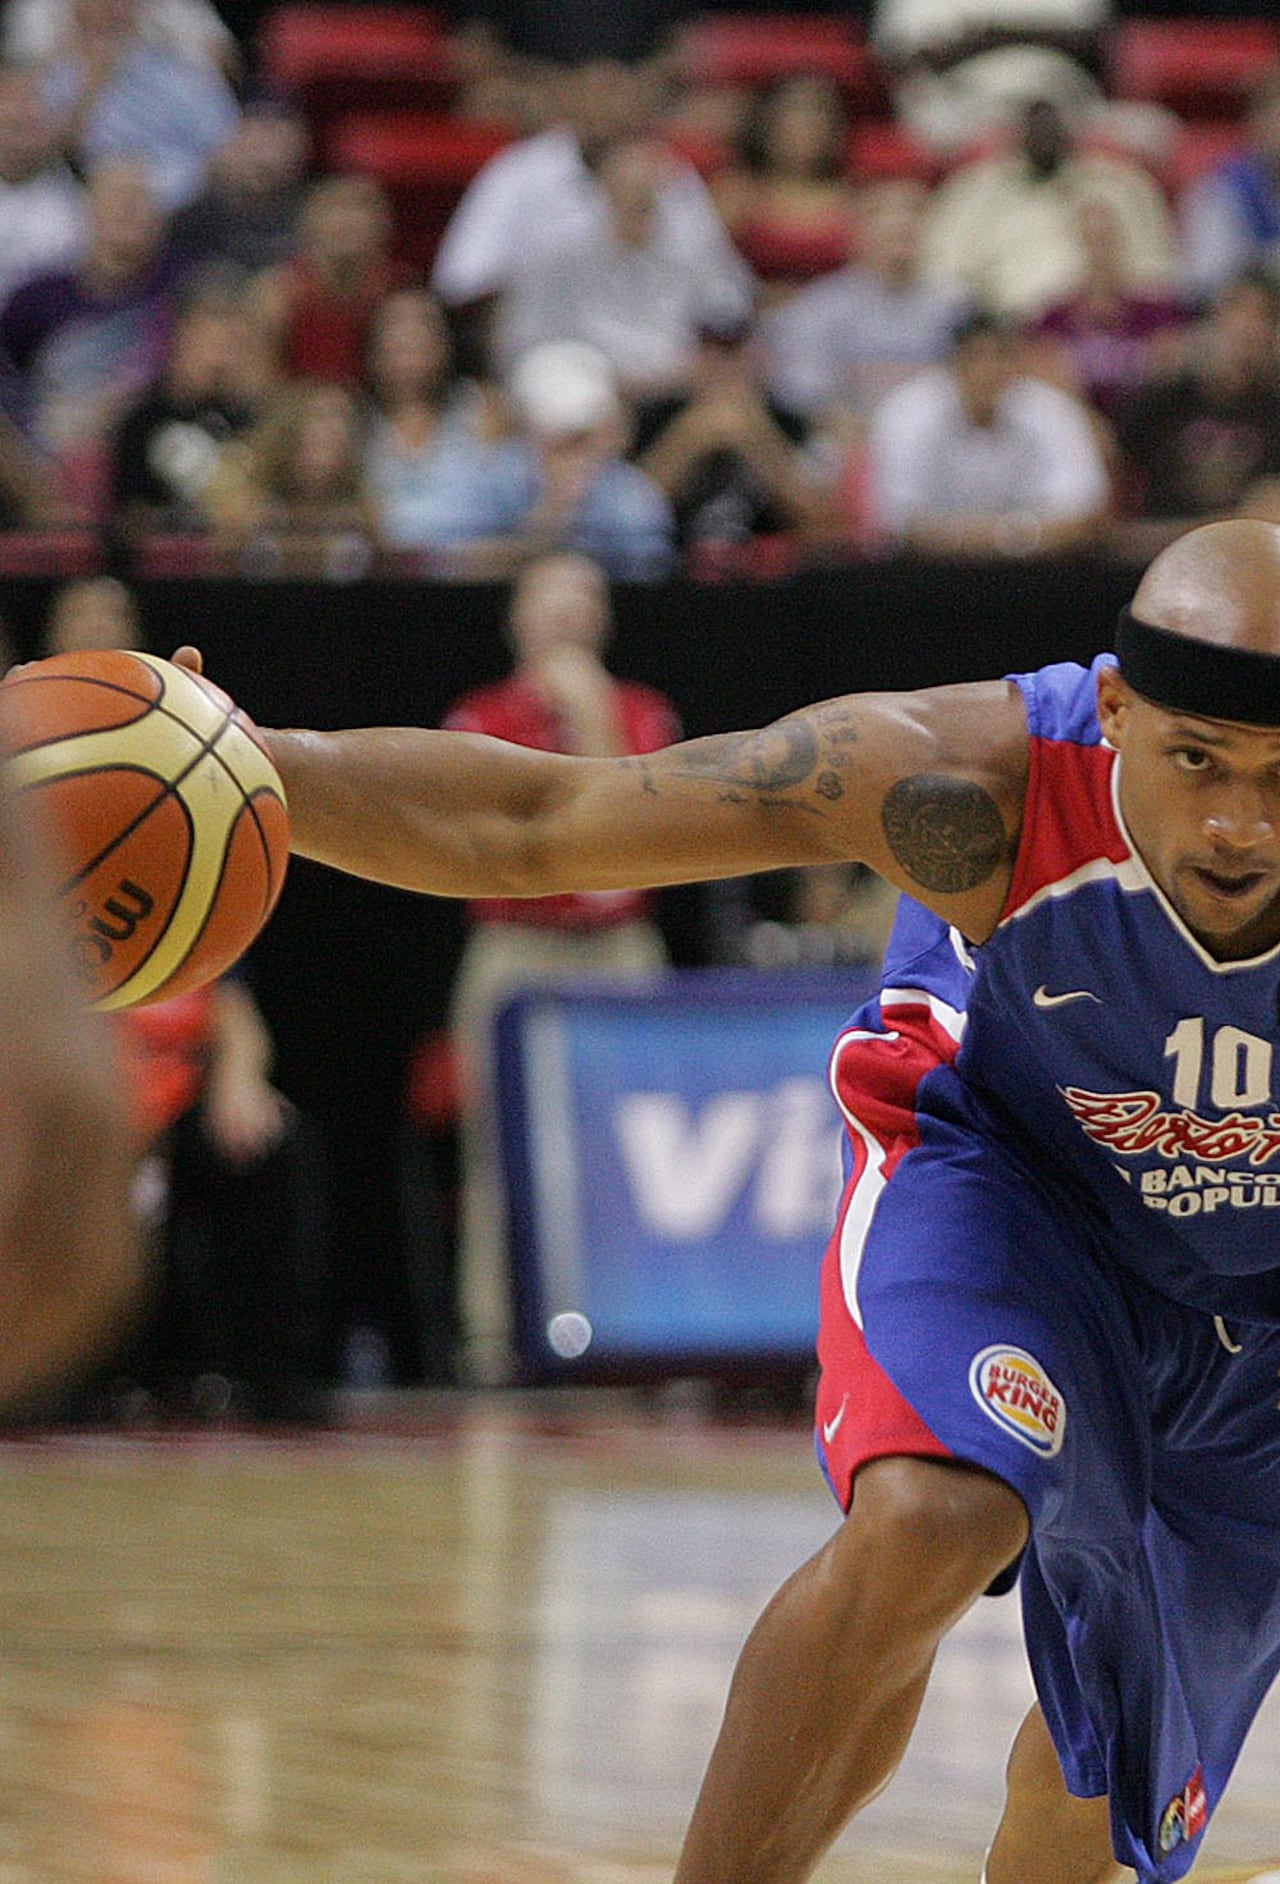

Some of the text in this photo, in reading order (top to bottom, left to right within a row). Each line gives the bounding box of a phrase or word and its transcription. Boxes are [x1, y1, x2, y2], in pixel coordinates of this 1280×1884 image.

[1163, 1016, 1273, 1110] 10
[614, 1080, 842, 1236] vi
[986, 1380, 1059, 1434] KING
[988, 1364, 1060, 1414] BURGER
